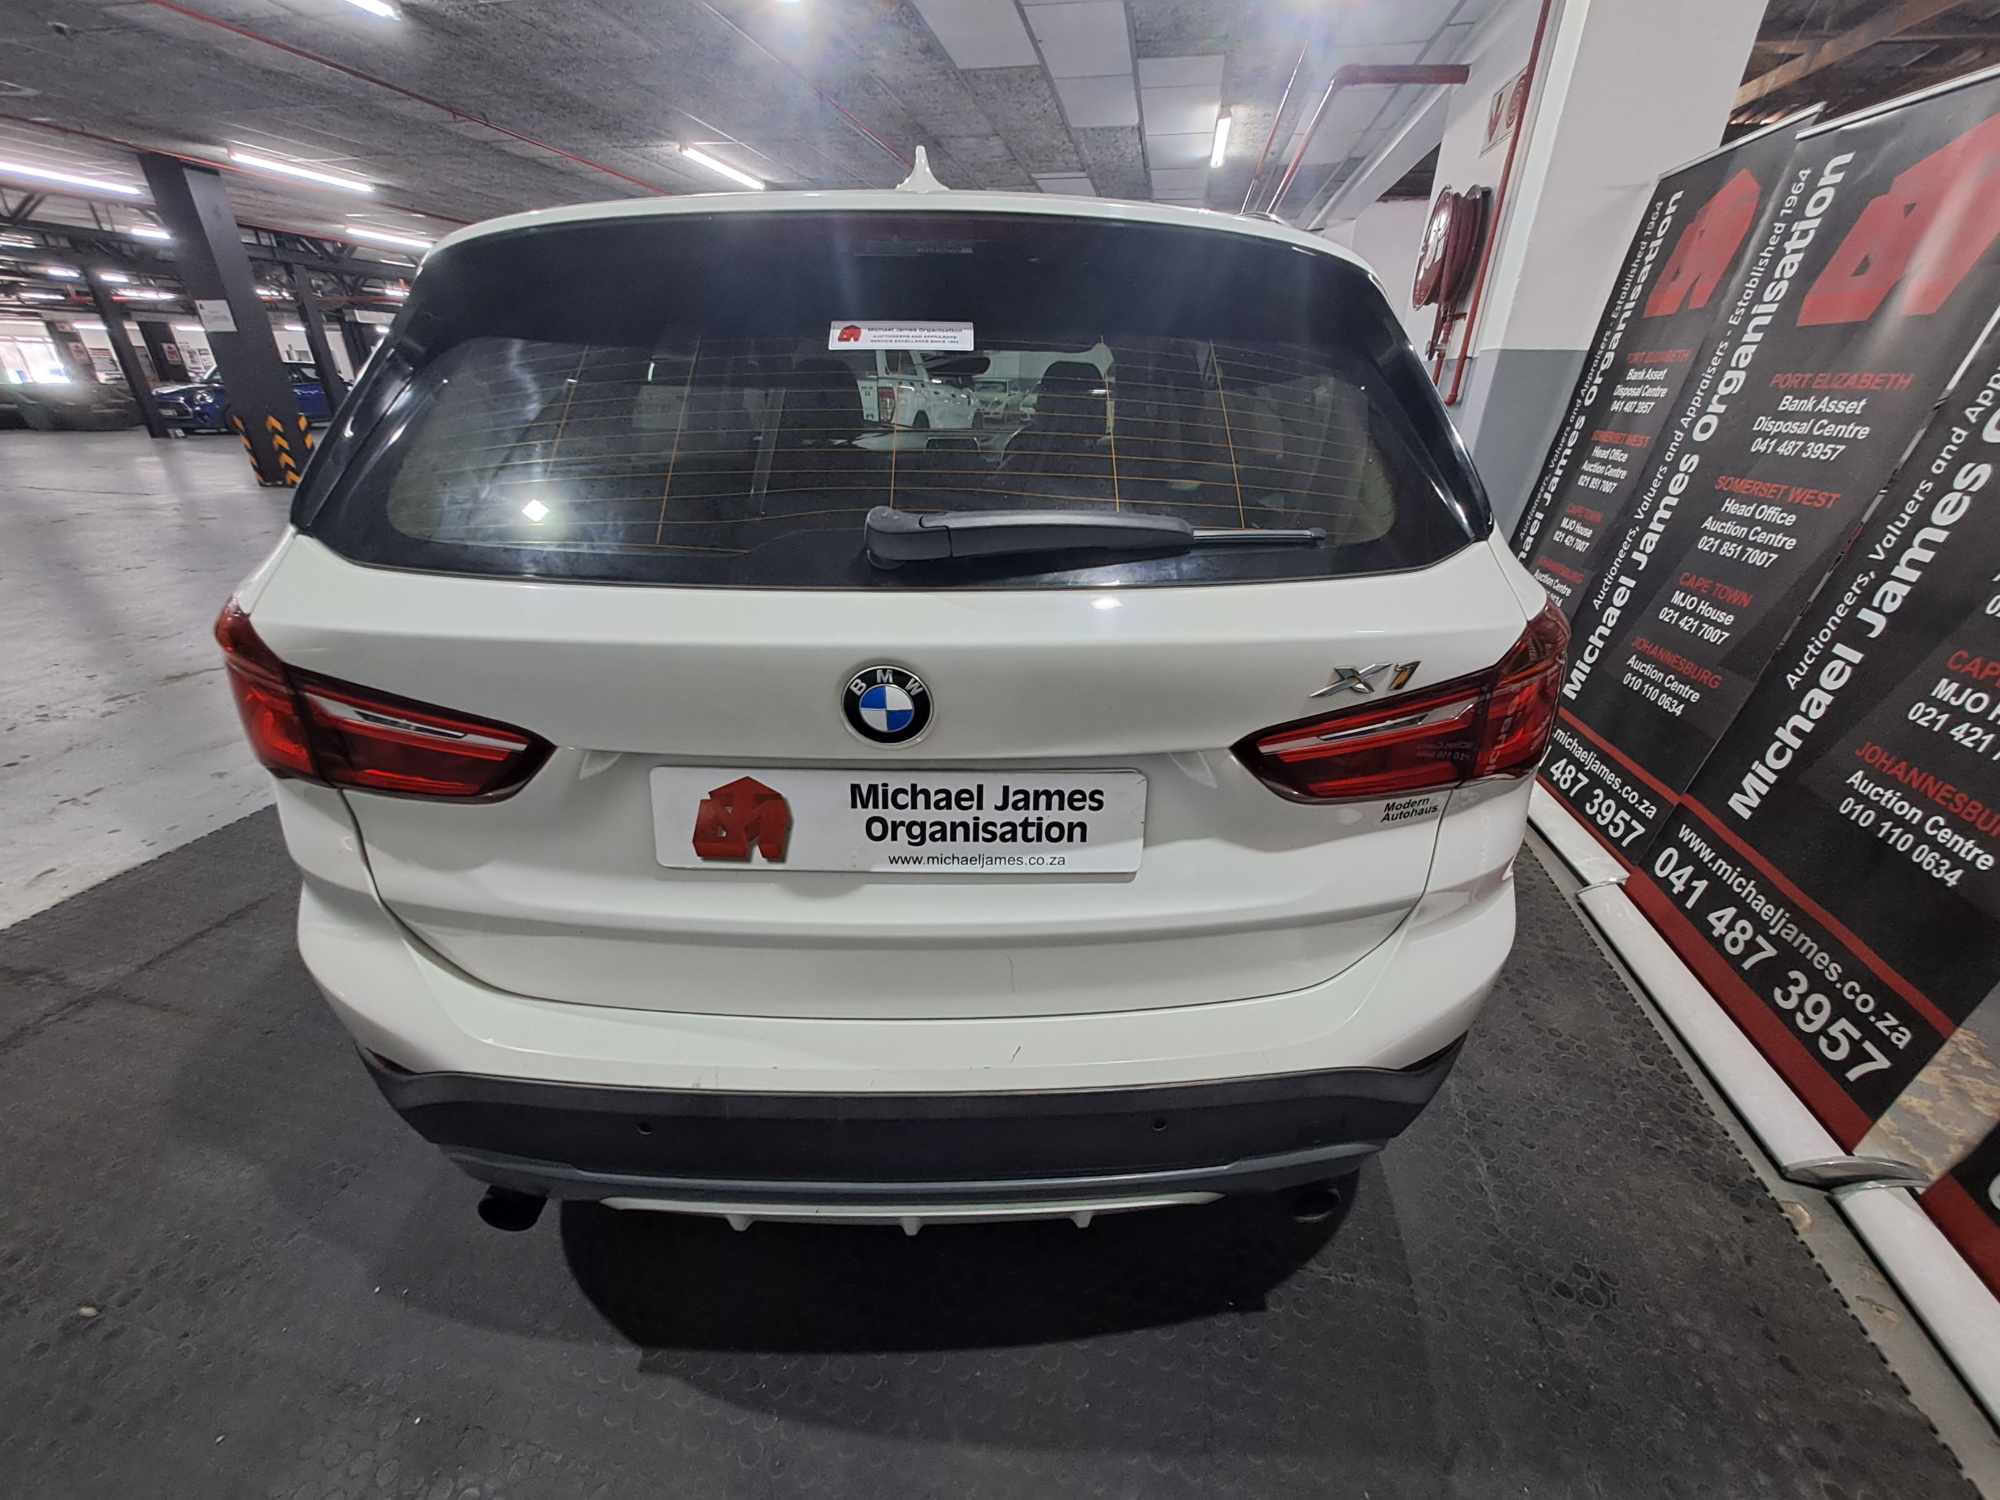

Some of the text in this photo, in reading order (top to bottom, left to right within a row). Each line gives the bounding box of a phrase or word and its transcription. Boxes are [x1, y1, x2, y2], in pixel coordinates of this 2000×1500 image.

[1543, 415, 1586, 507] James
[1584, 190, 1685, 406] Organisation
[1569, 398, 1583, 423] and
[1611, 240, 1647, 319] Established
[1593, 526, 1640, 611] Auctioneers,
[1633, 464, 1667, 520] Valuers
[1665, 430, 1684, 462] and
[1680, 340, 1729, 429] Appraisers
[1729, 222, 1785, 326] Established
[1781, 167, 1812, 217] 1964
[1770, 371, 1914, 390] PORT ELIZABETH
[1778, 395, 1866, 414] Bank Asset
[1562, 574, 1637, 700] Michael
[1631, 453, 1700, 570] James
[1692, 152, 1856, 442] Organisation
[1752, 416, 1870, 439] Disposal Centre
[1751, 438, 1846, 461] 041 487 3957
[1714, 475, 1841, 510] SOMERSET WEST
[1721, 498, 1797, 526] Head Office
[1698, 535, 1778, 568] 021 851 7007
[1701, 516, 1797, 550] Auction Centre
[1786, 427, 1969, 690] Auctioneers, Valuers and
[1671, 590, 1734, 626] MJO House
[1679, 571, 1753, 608] CAPE TOWN
[1658, 606, 1730, 645] 021 421 7007
[1727, 461, 1992, 820] Michael James
[1626, 654, 1701, 703] Auction Centre
[1631, 636, 1724, 689] JOHANNESBURG
[1945, 650, 2000, 688] CAP
[849, 669, 924, 697] BMW
[1622, 672, 1684, 718] 010 110 0634
[1930, 678, 1990, 714] MJO
[1907, 702, 1996, 753] 021 421
[849, 783, 1105, 812] Michael James
[1381, 805, 1438, 823] Autohaus
[1384, 797, 1430, 813] Modern
[1550, 758, 1646, 848] 487 3957
[864, 815, 1088, 844] Organisation
[1845, 770, 1995, 870] Auction Centre
[888, 853, 1066, 868] www.michaeljames.co.za
[1838, 797, 1965, 887] 010 110 0634
[1677, 824, 1912, 1050] www.michaeljames.co.za
[1653, 846, 1892, 1082] 041 487 3957
